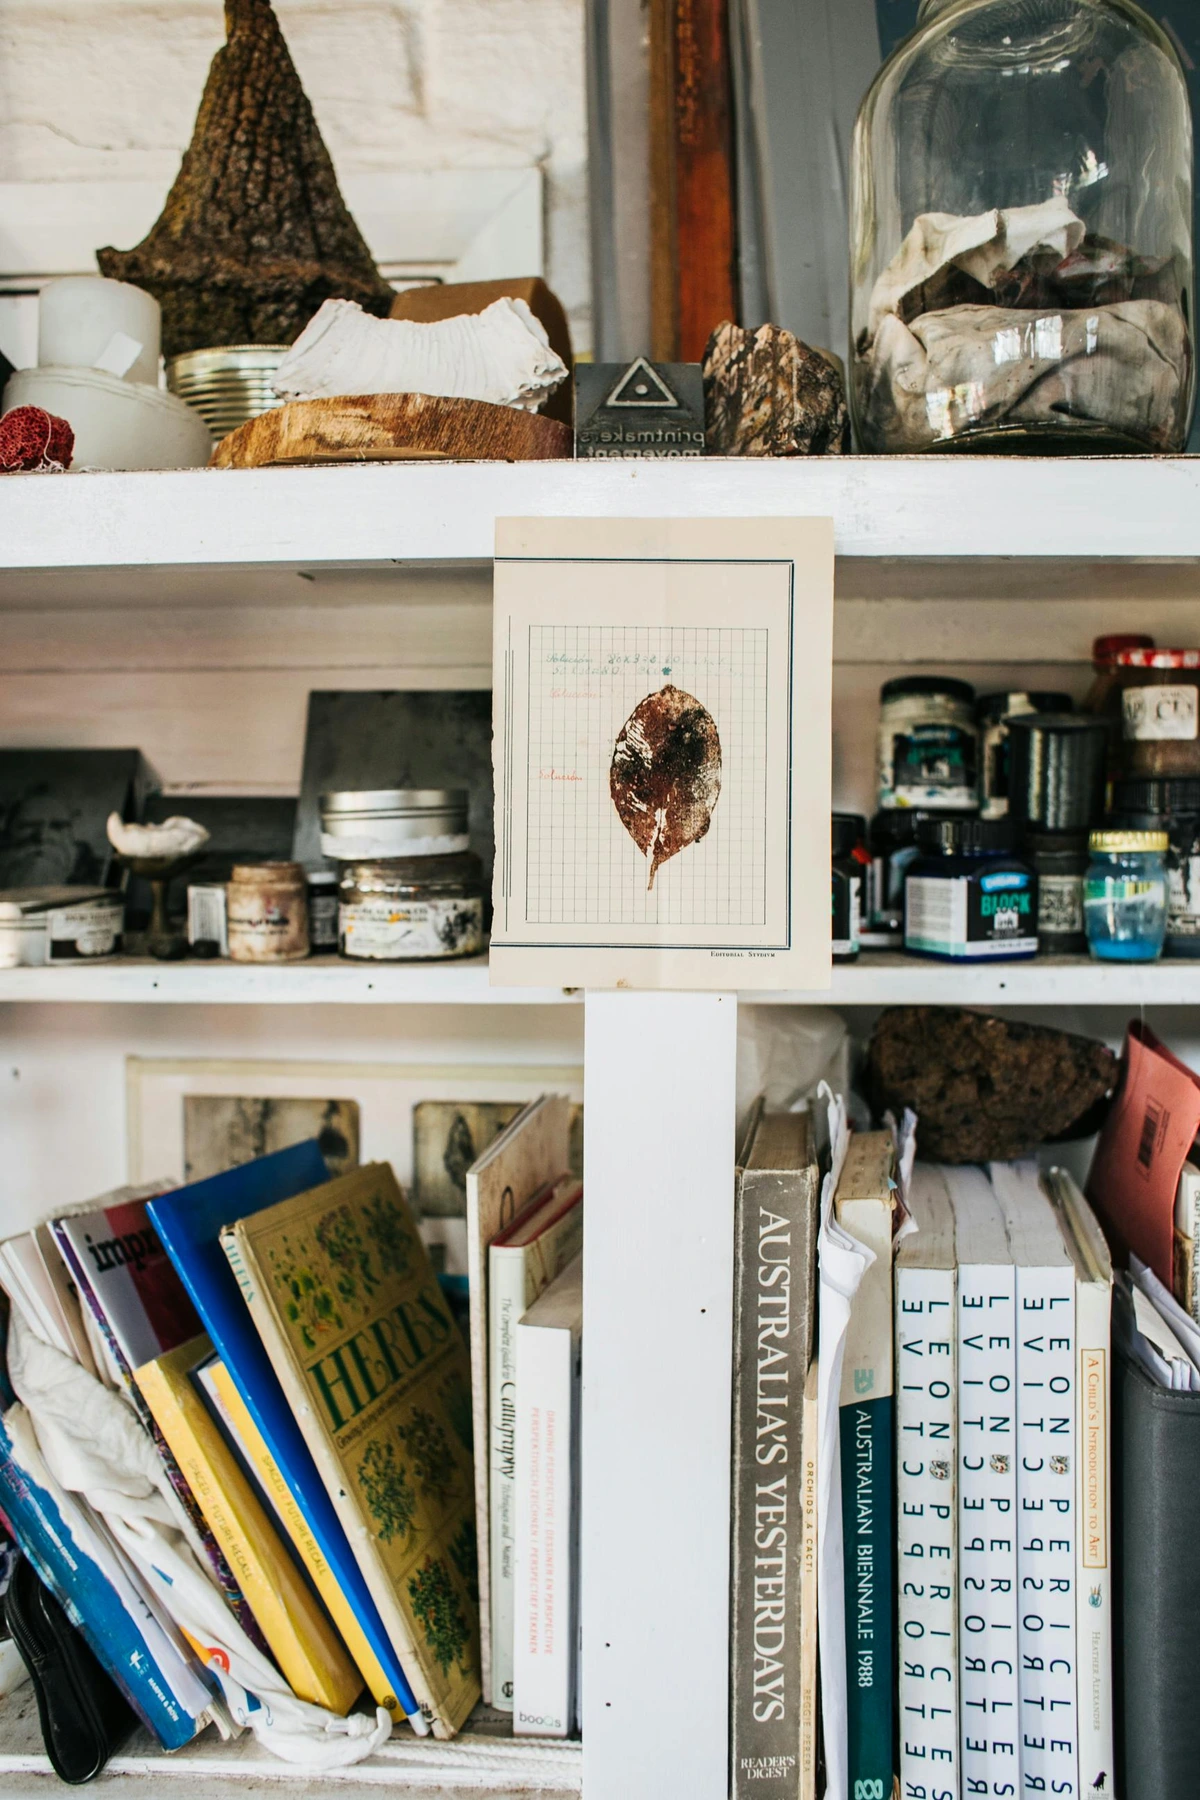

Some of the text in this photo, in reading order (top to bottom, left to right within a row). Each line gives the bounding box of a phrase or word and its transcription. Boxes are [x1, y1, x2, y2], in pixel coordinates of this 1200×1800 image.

[981, 893, 1031, 917] BLOCK
[501, 1298, 512, 1313] The
[307, 1289, 453, 1434] HERBS
[1087, 1373, 1100, 1421] CHILD'S
[1088, 1357, 1099, 1368] A
[493, 1381, 516, 1480] Calligraphy
[752, 1206, 792, 1723] AUSTRALIA'S YESTERDAYS
[1087, 1425, 1100, 1508] INTRODUCTION
[188, 1458, 253, 1582] SPACED 2 FUTURE RECALL
[260, 1454, 285, 1493] SPACED
[285, 1499, 310, 1538] FUTURE
[305, 1535, 327, 1576] RECALL
[529, 1489, 540, 1538] ZEICHNEN
[543, 1410, 556, 1656] DRAWING PERSPECTIVE DESSINER EN PERSPECTIVE
[805, 1462, 814, 1573] ORCHIDS & CACTI
[855, 1409, 874, 1688] AUSTRALIAN BIENNALE 1988
[928, 1301, 953, 1800] LEON PERICLES
[989, 1295, 1014, 1796] LEON PERICLES
[1049, 1297, 1072, 1794] LEON PERICLES
[1088, 1534, 1100, 1559] ART
[529, 1547, 539, 1610] PERSPECTIEF
[528, 1612, 539, 1655] TEKENEN
[148, 1677, 166, 1702] HARPER
[166, 1705, 179, 1722] ROW
[1092, 1631, 1101, 1732] HEATHER ALEXANDER
[740, 1755, 796, 1770] READER'S
[746, 1766, 790, 1779] DIGEST
[802, 1689, 812, 1773] REGGIE PERERA
